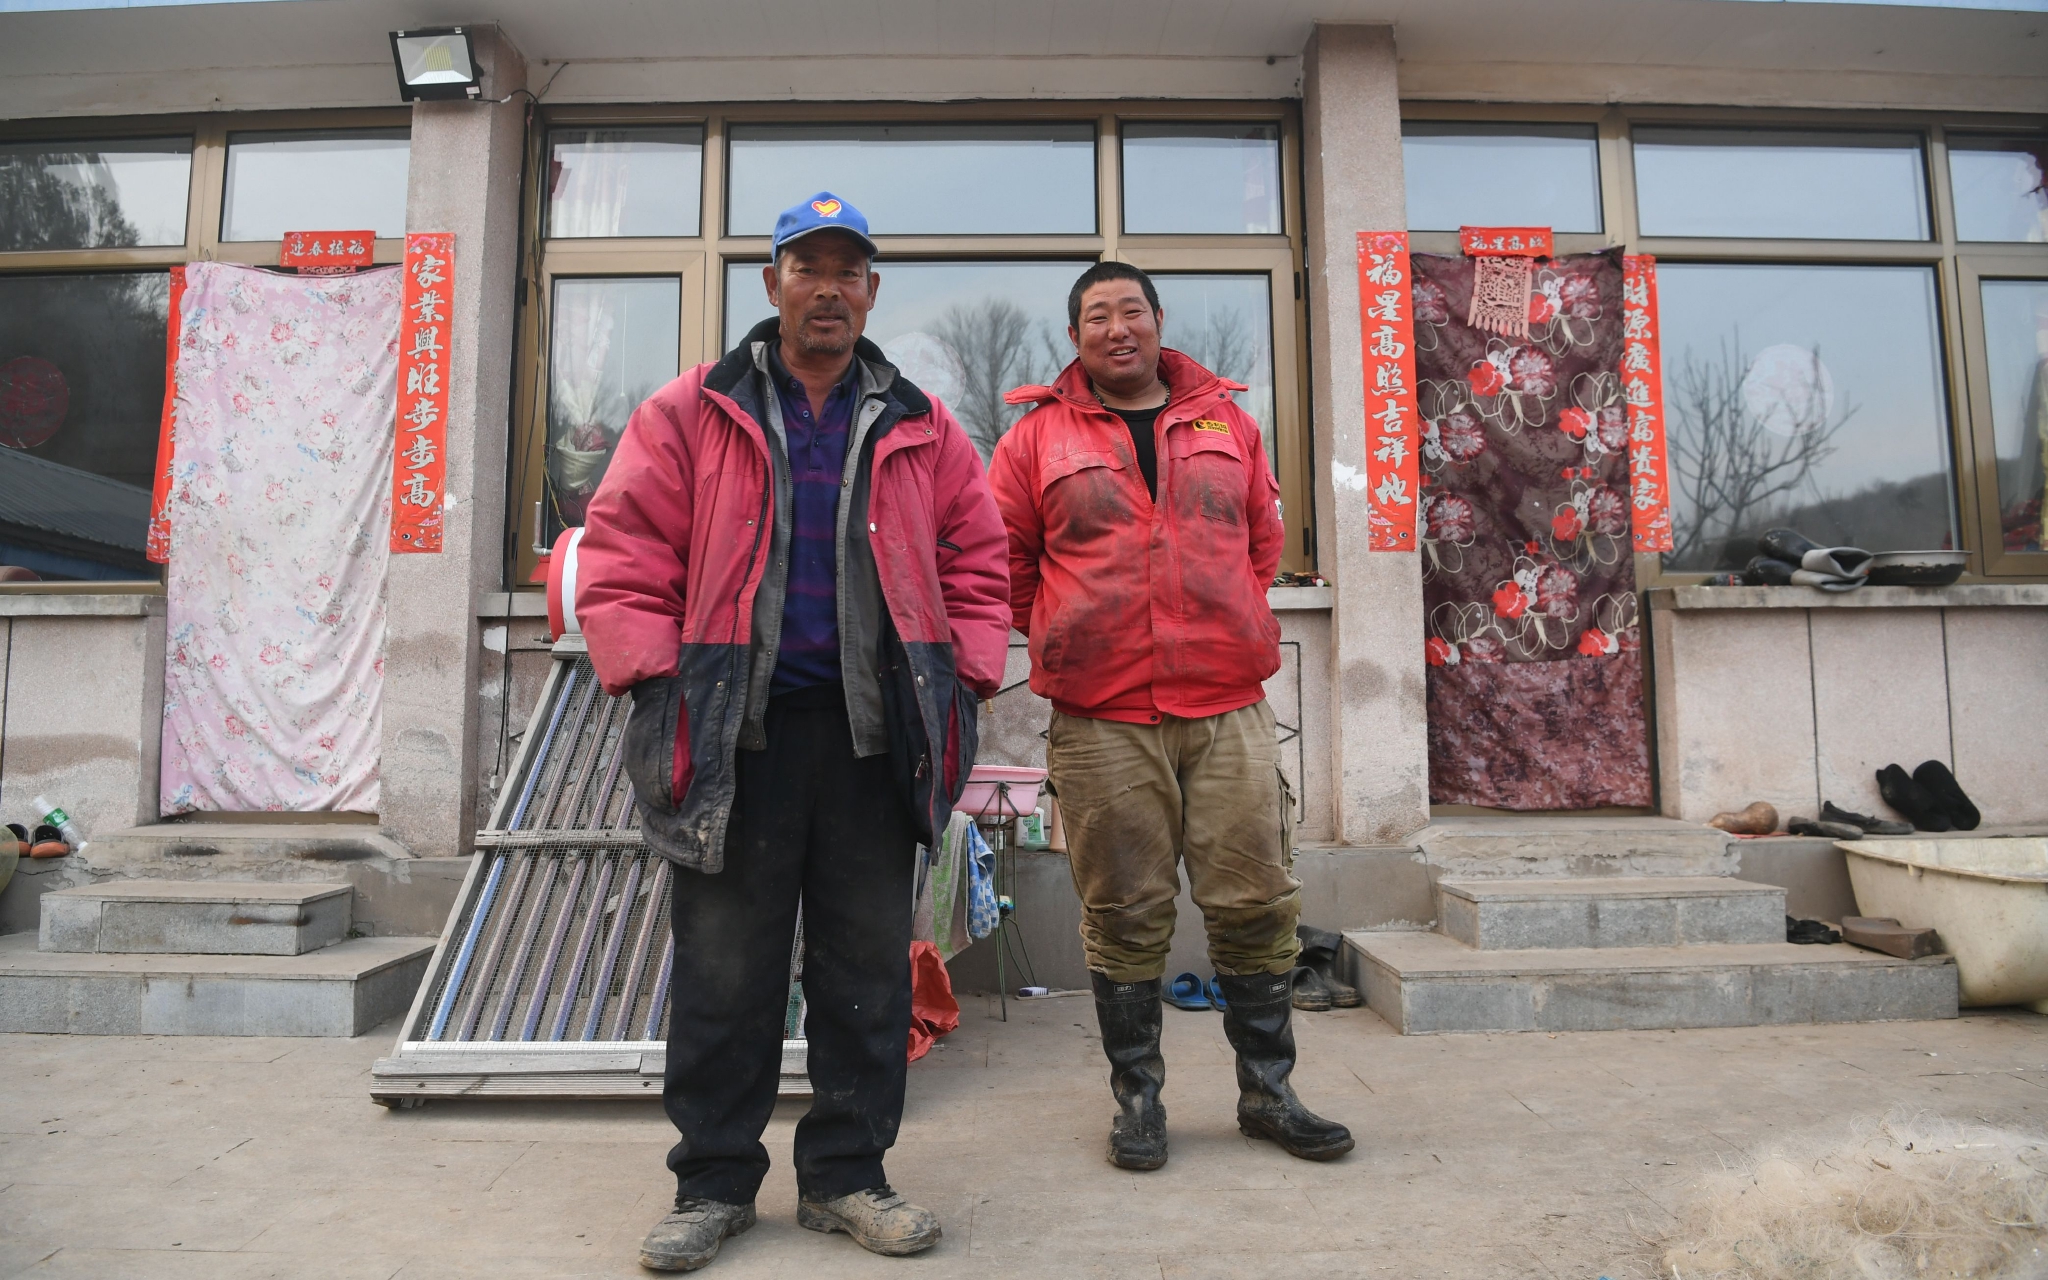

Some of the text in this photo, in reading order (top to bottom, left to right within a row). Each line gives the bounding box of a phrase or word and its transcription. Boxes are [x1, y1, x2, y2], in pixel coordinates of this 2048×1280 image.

[1470, 235, 1545, 251] 福星高照
[399, 254, 447, 508] 家業興旺步步高
[1365, 253, 1412, 507] 福星高照吉祥地
